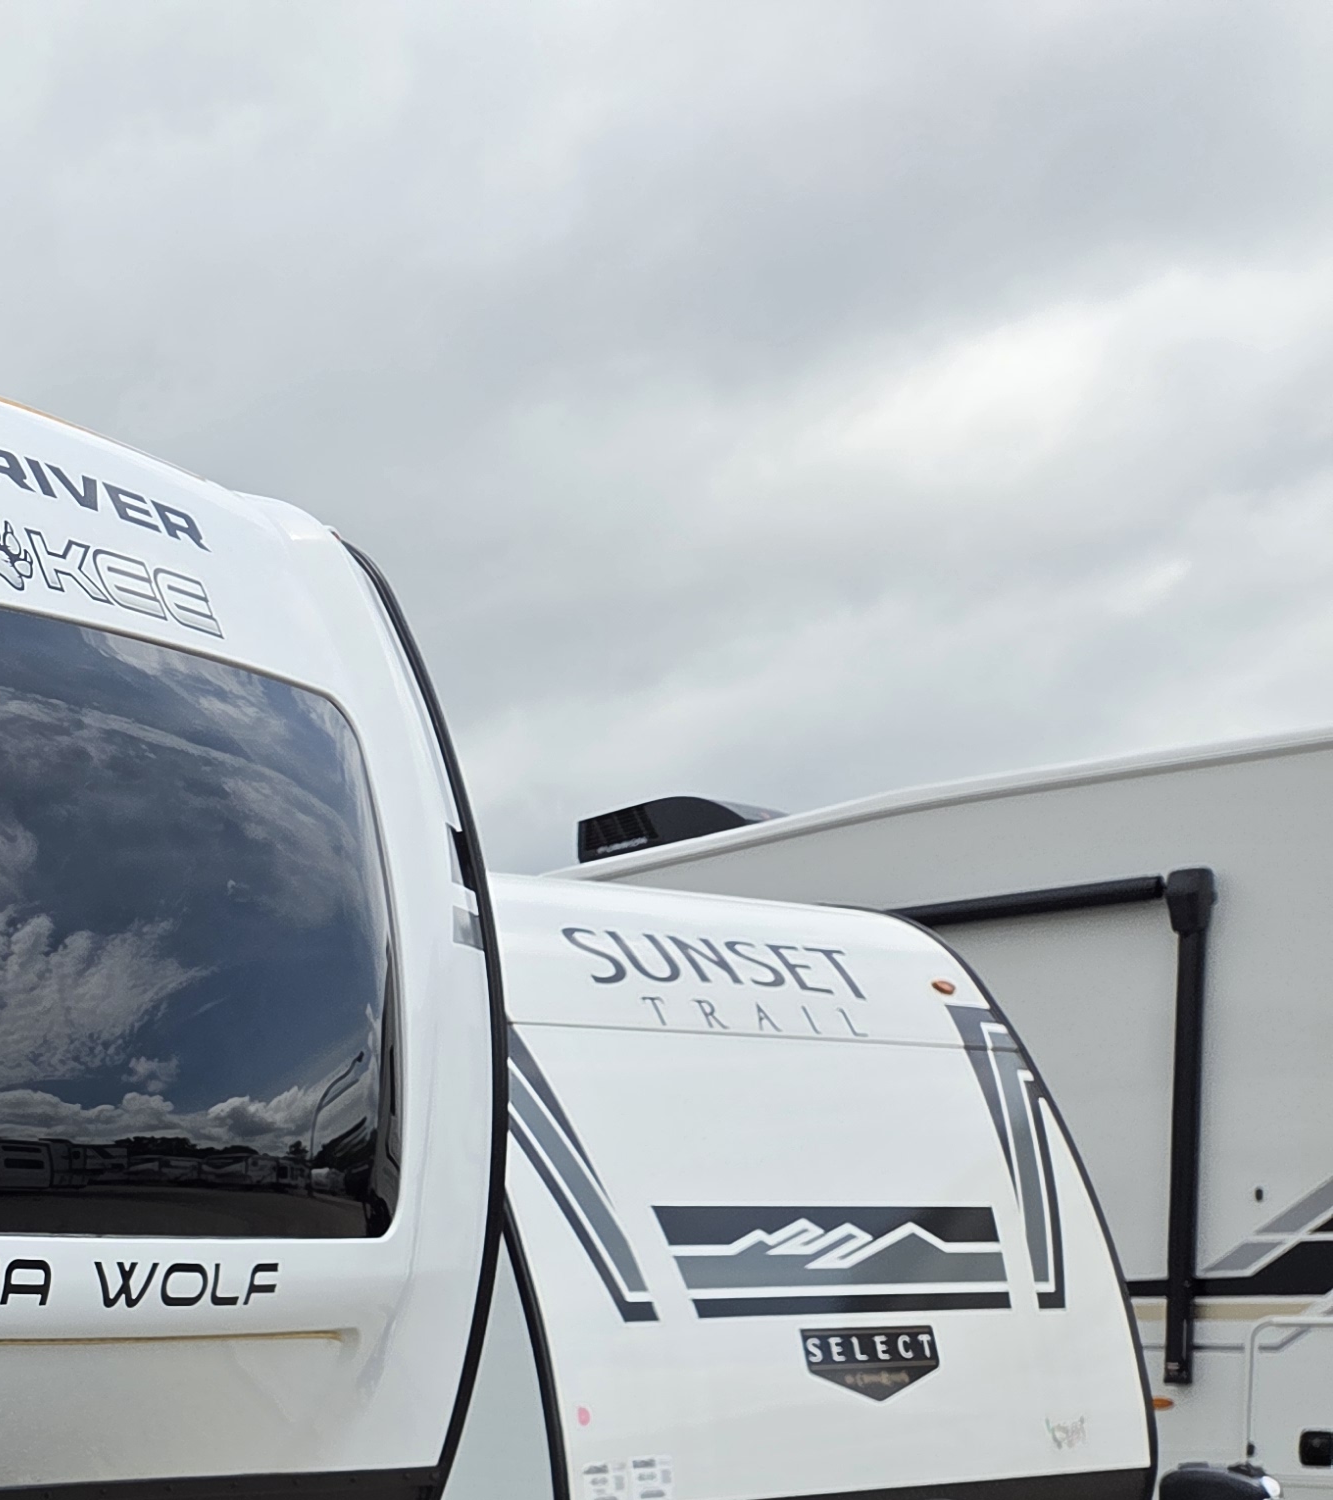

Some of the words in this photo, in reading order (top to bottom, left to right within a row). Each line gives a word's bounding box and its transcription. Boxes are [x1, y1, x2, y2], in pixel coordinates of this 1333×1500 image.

[561, 926, 868, 1001] SUNSET
[640, 996, 869, 1038] TRAIL
[93, 1261, 280, 1309] WOLF
[805, 1333, 933, 1363] SELECT
